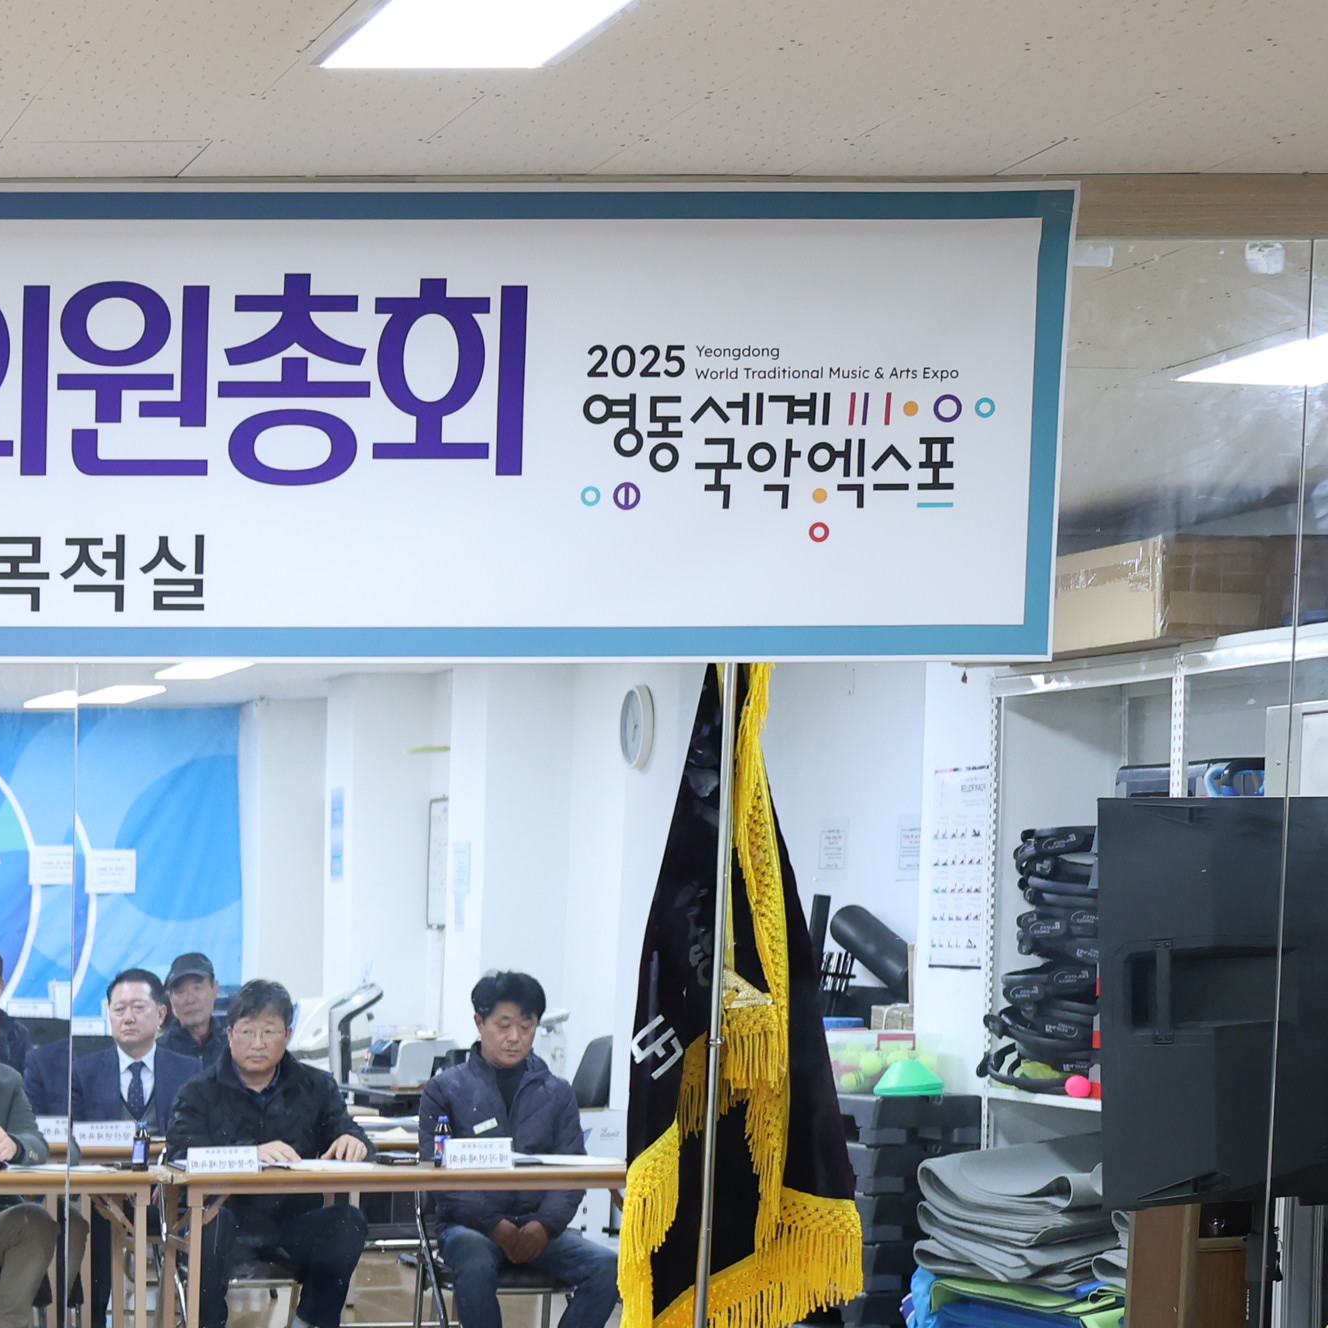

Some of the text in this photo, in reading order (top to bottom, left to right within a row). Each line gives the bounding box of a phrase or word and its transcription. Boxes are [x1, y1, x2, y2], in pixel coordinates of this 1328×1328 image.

[587, 345, 685, 378] 2025
[696, 345, 780, 361] Yeongdong
[695, 366, 960, 383] World Traditional Music & Arts Expo
[583, 392, 831, 473] 영동세계
[695, 436, 955, 510] 국악엑스포
